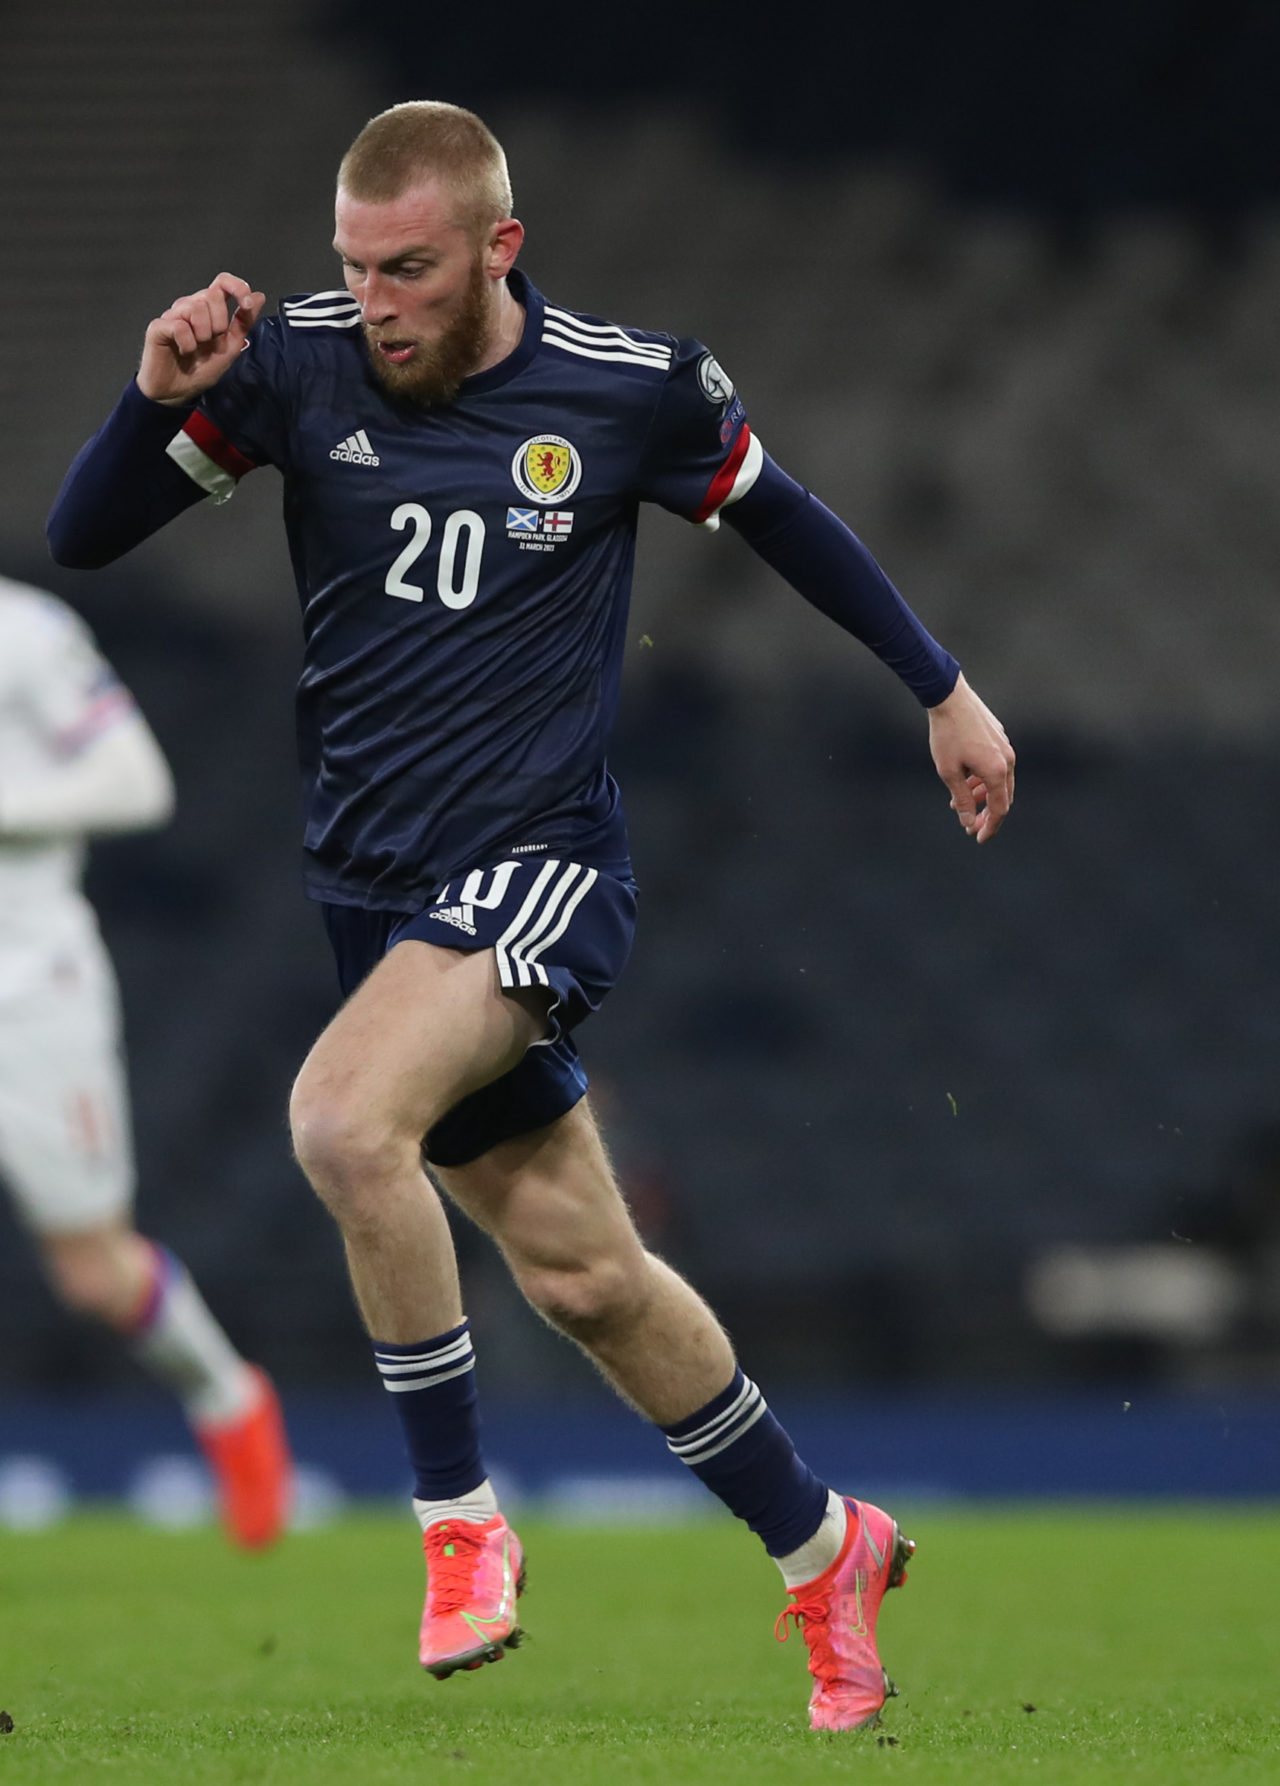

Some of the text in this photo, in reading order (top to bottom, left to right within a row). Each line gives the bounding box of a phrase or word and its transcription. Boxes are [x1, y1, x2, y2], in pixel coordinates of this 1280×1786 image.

[532, 436, 568, 446] SCOTLAND
[330, 449, 380, 467] adidas
[385, 502, 486, 610] 20
[429, 911, 478, 936] adidas
